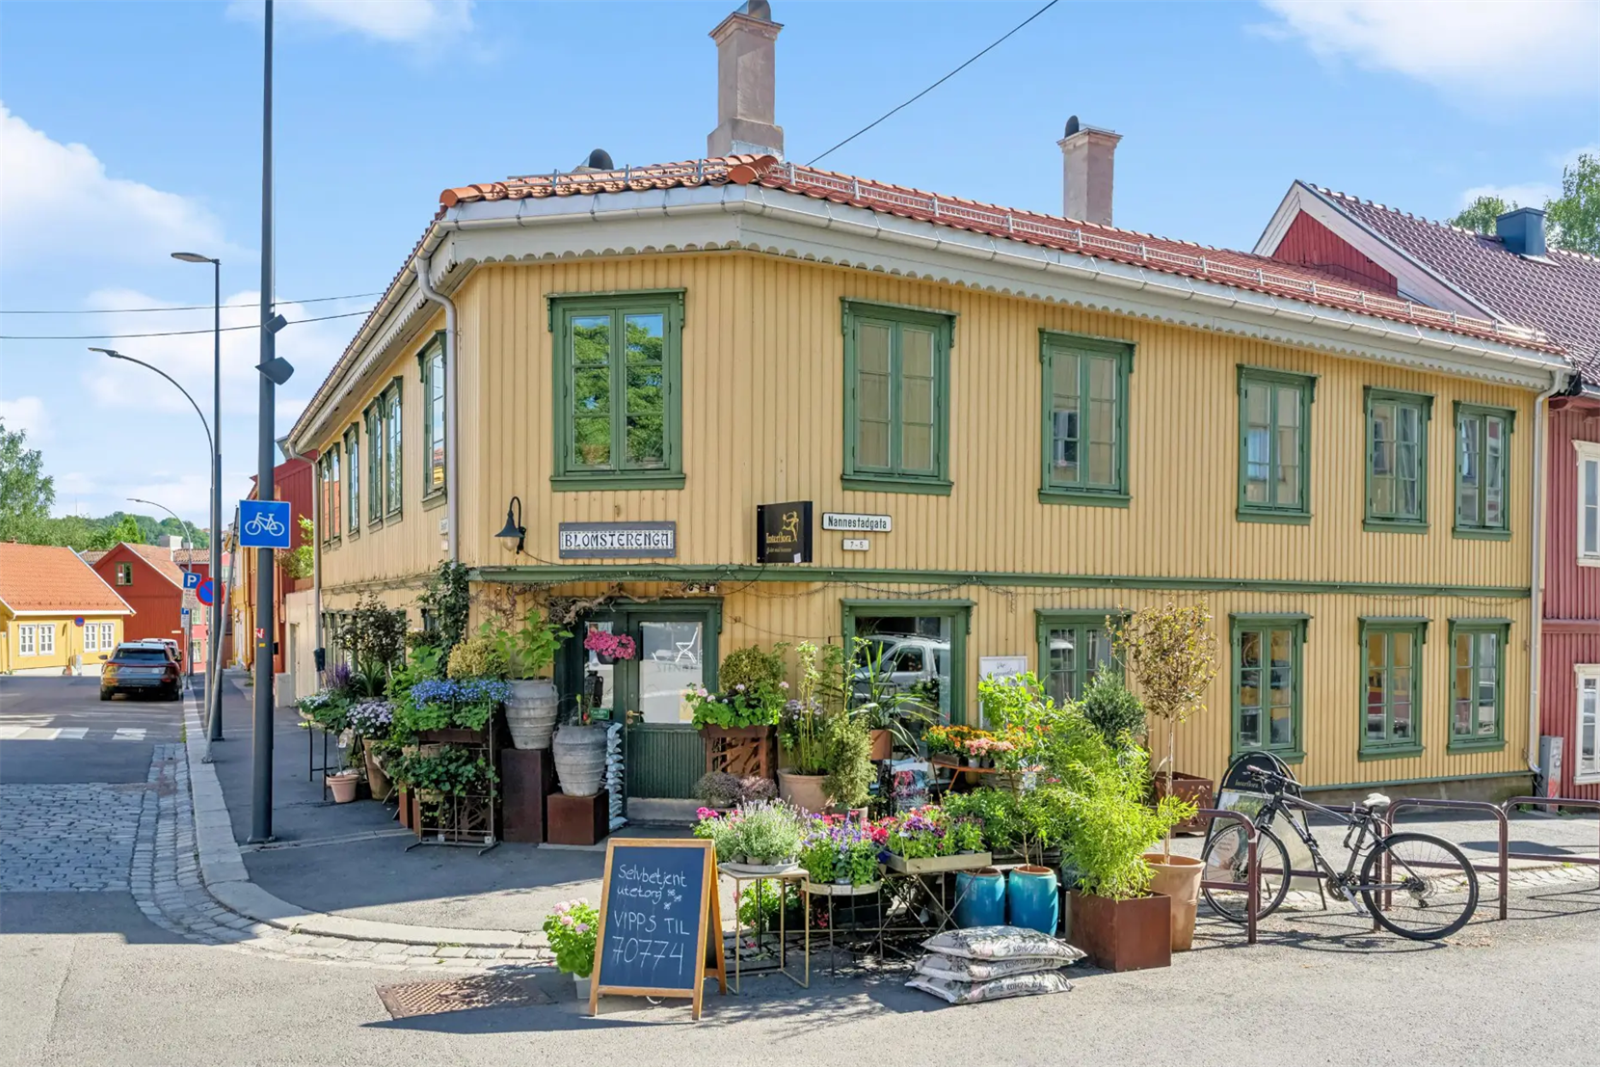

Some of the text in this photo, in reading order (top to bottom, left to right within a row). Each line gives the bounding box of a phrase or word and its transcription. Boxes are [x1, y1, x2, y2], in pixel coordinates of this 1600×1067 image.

[828, 515, 887, 530] Nannestadgata
[565, 533, 669, 547] BLOMSTERENGA
[187, 575, 197, 587] P
[618, 864, 687, 889] Selvbetjent
[616, 886, 662, 904] utetorg
[614, 910, 690, 935] VIPPS TIL
[612, 936, 684, 975] 70774
